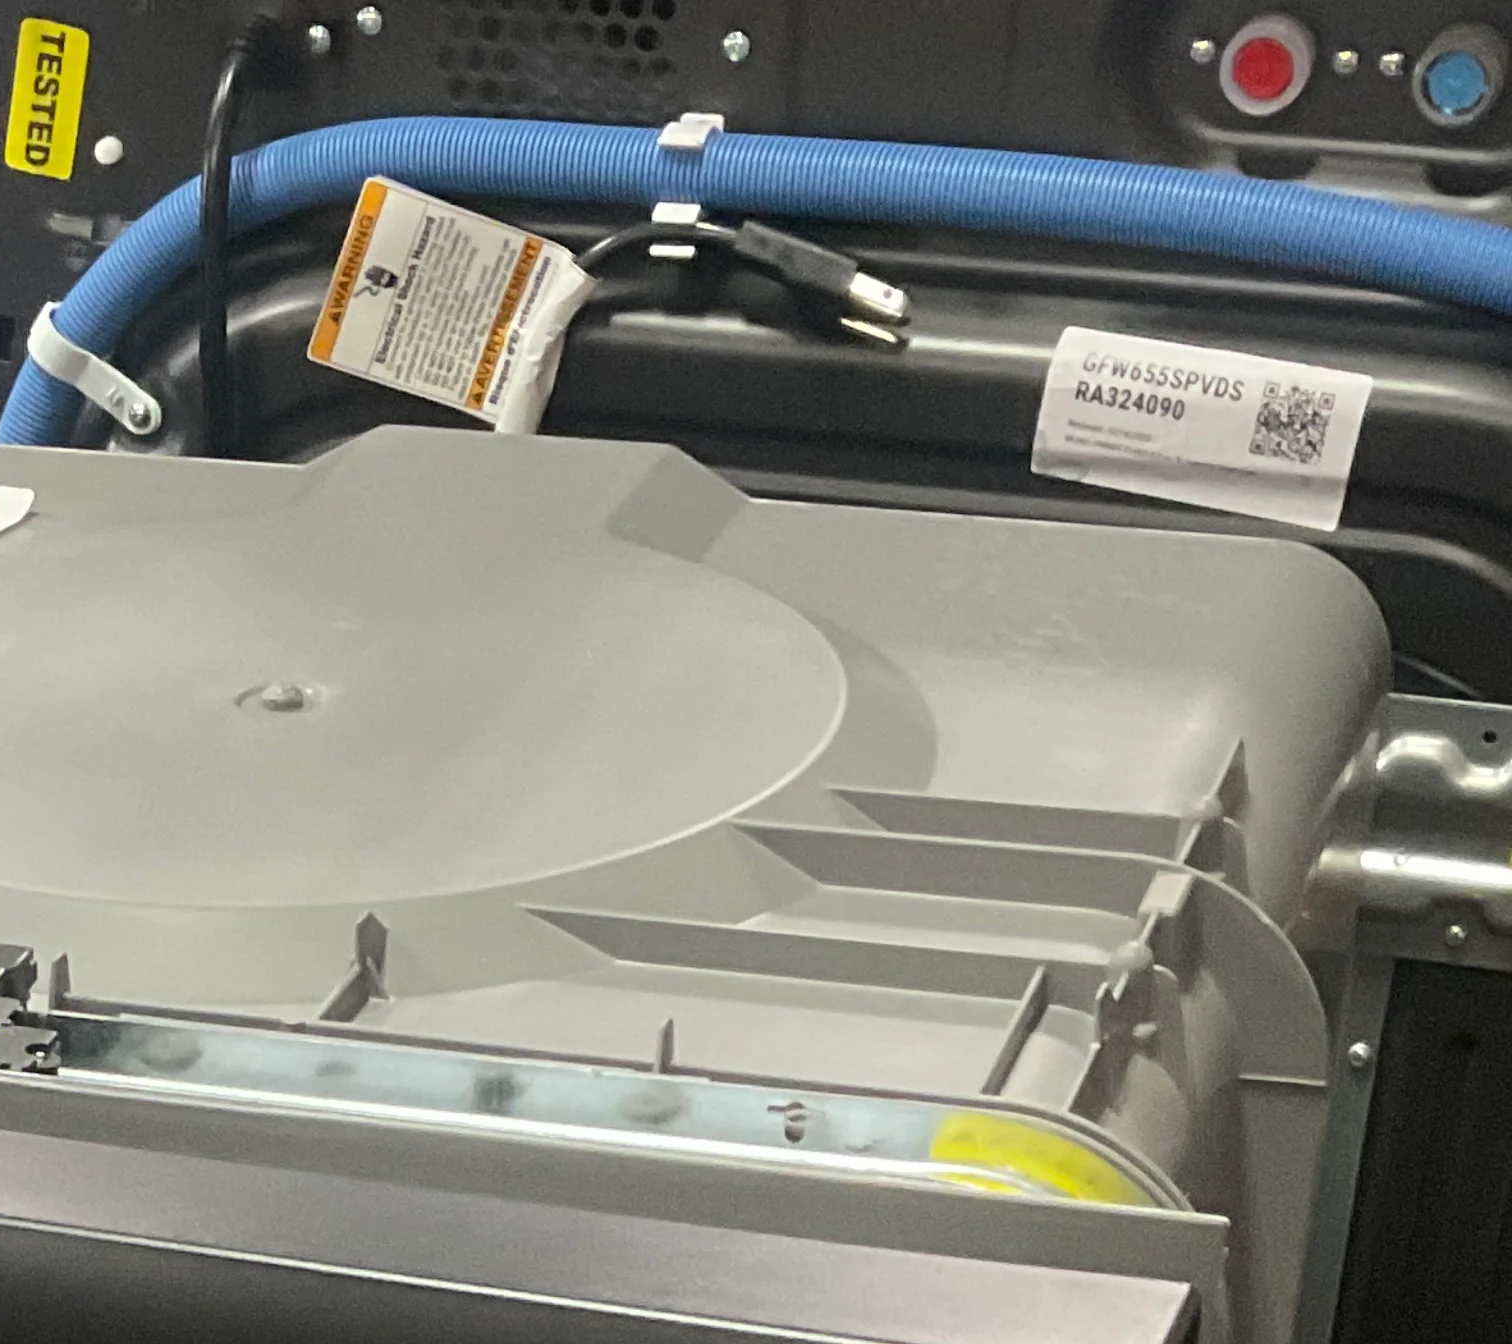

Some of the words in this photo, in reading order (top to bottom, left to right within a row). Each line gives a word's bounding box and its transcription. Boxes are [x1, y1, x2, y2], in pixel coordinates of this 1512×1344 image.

[25, 31, 66, 167] TESTED
[334, 214, 374, 308] WARNING
[375, 304, 403, 363] Electrical
[411, 215, 435, 260] Hazard
[1075, 380, 1185, 421] RA324090
[1082, 352, 1245, 401] GFW655SPVDS
